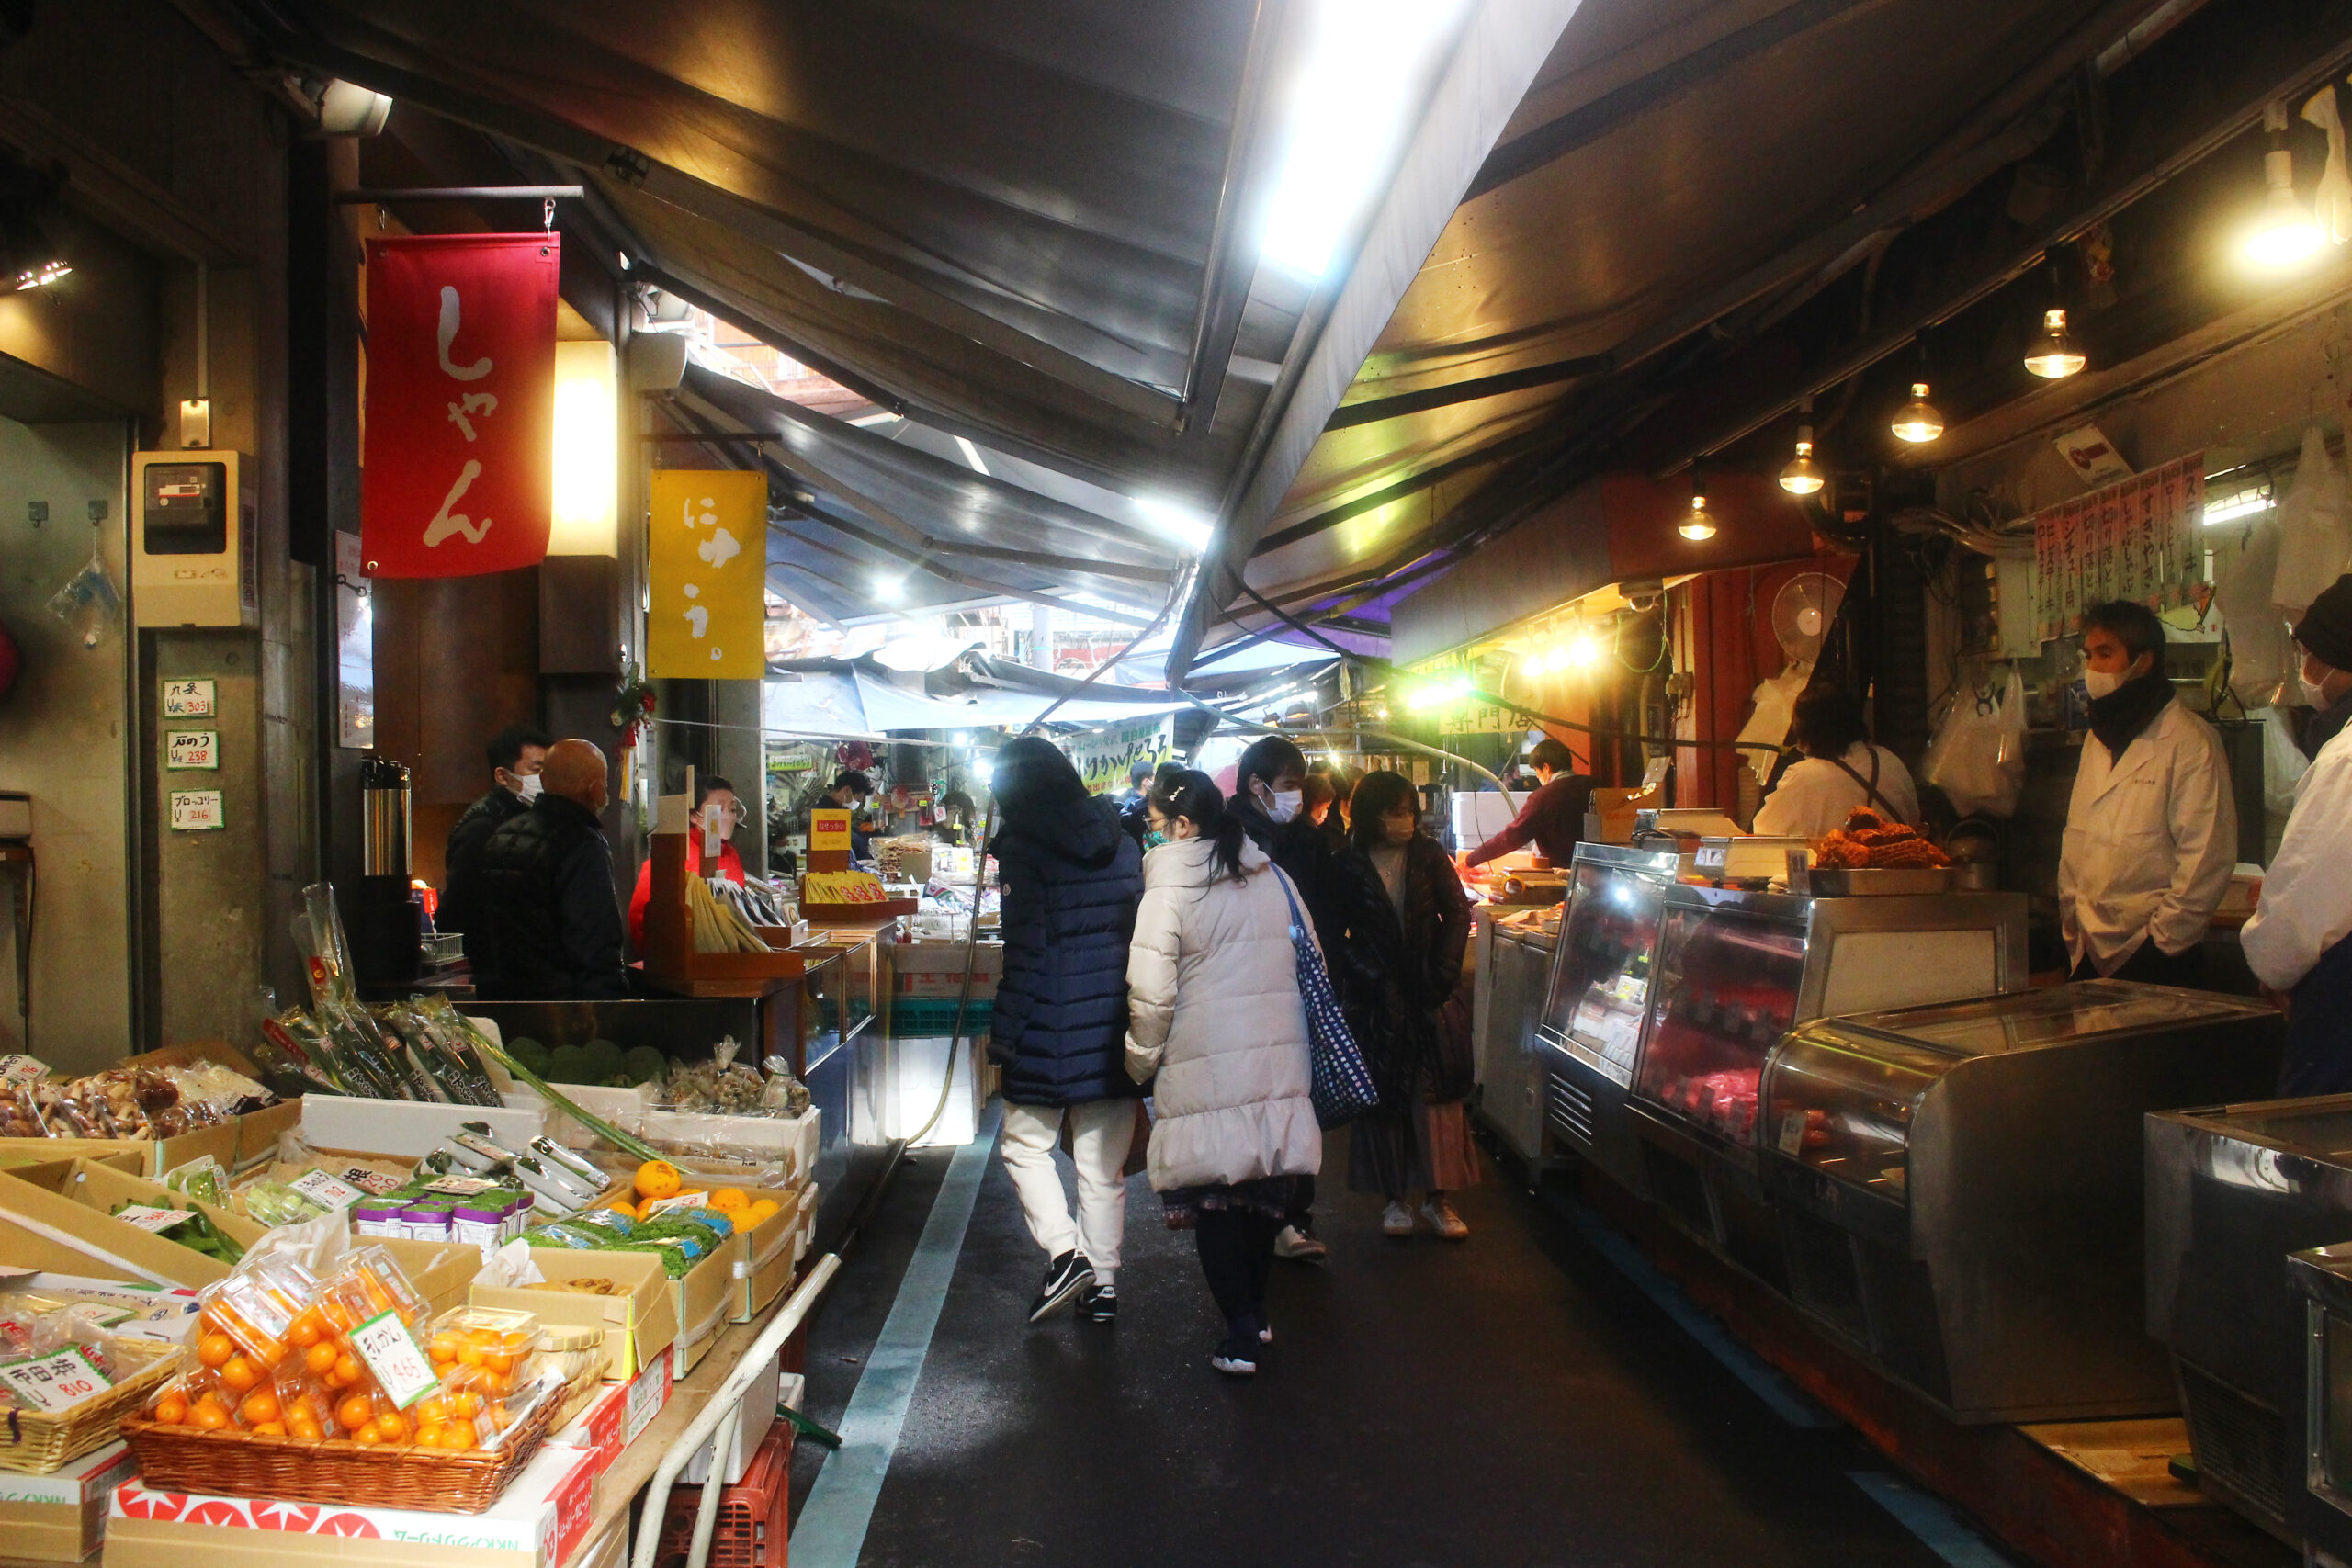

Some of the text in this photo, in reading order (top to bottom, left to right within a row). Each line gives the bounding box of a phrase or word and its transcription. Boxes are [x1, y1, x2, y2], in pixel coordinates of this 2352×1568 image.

[423, 286, 498, 547] しゃん
[170, 682, 201, 696] 九条
[187, 701, 207, 713] 303
[188, 751, 208, 761] 238
[175, 796, 219, 807] ブロッコリー
[190, 810, 209, 819] 216
[9, 1359, 77, 1384] 市田柿
[393, 1357, 421, 1382] 465
[58, 1379, 93, 1397] 810
